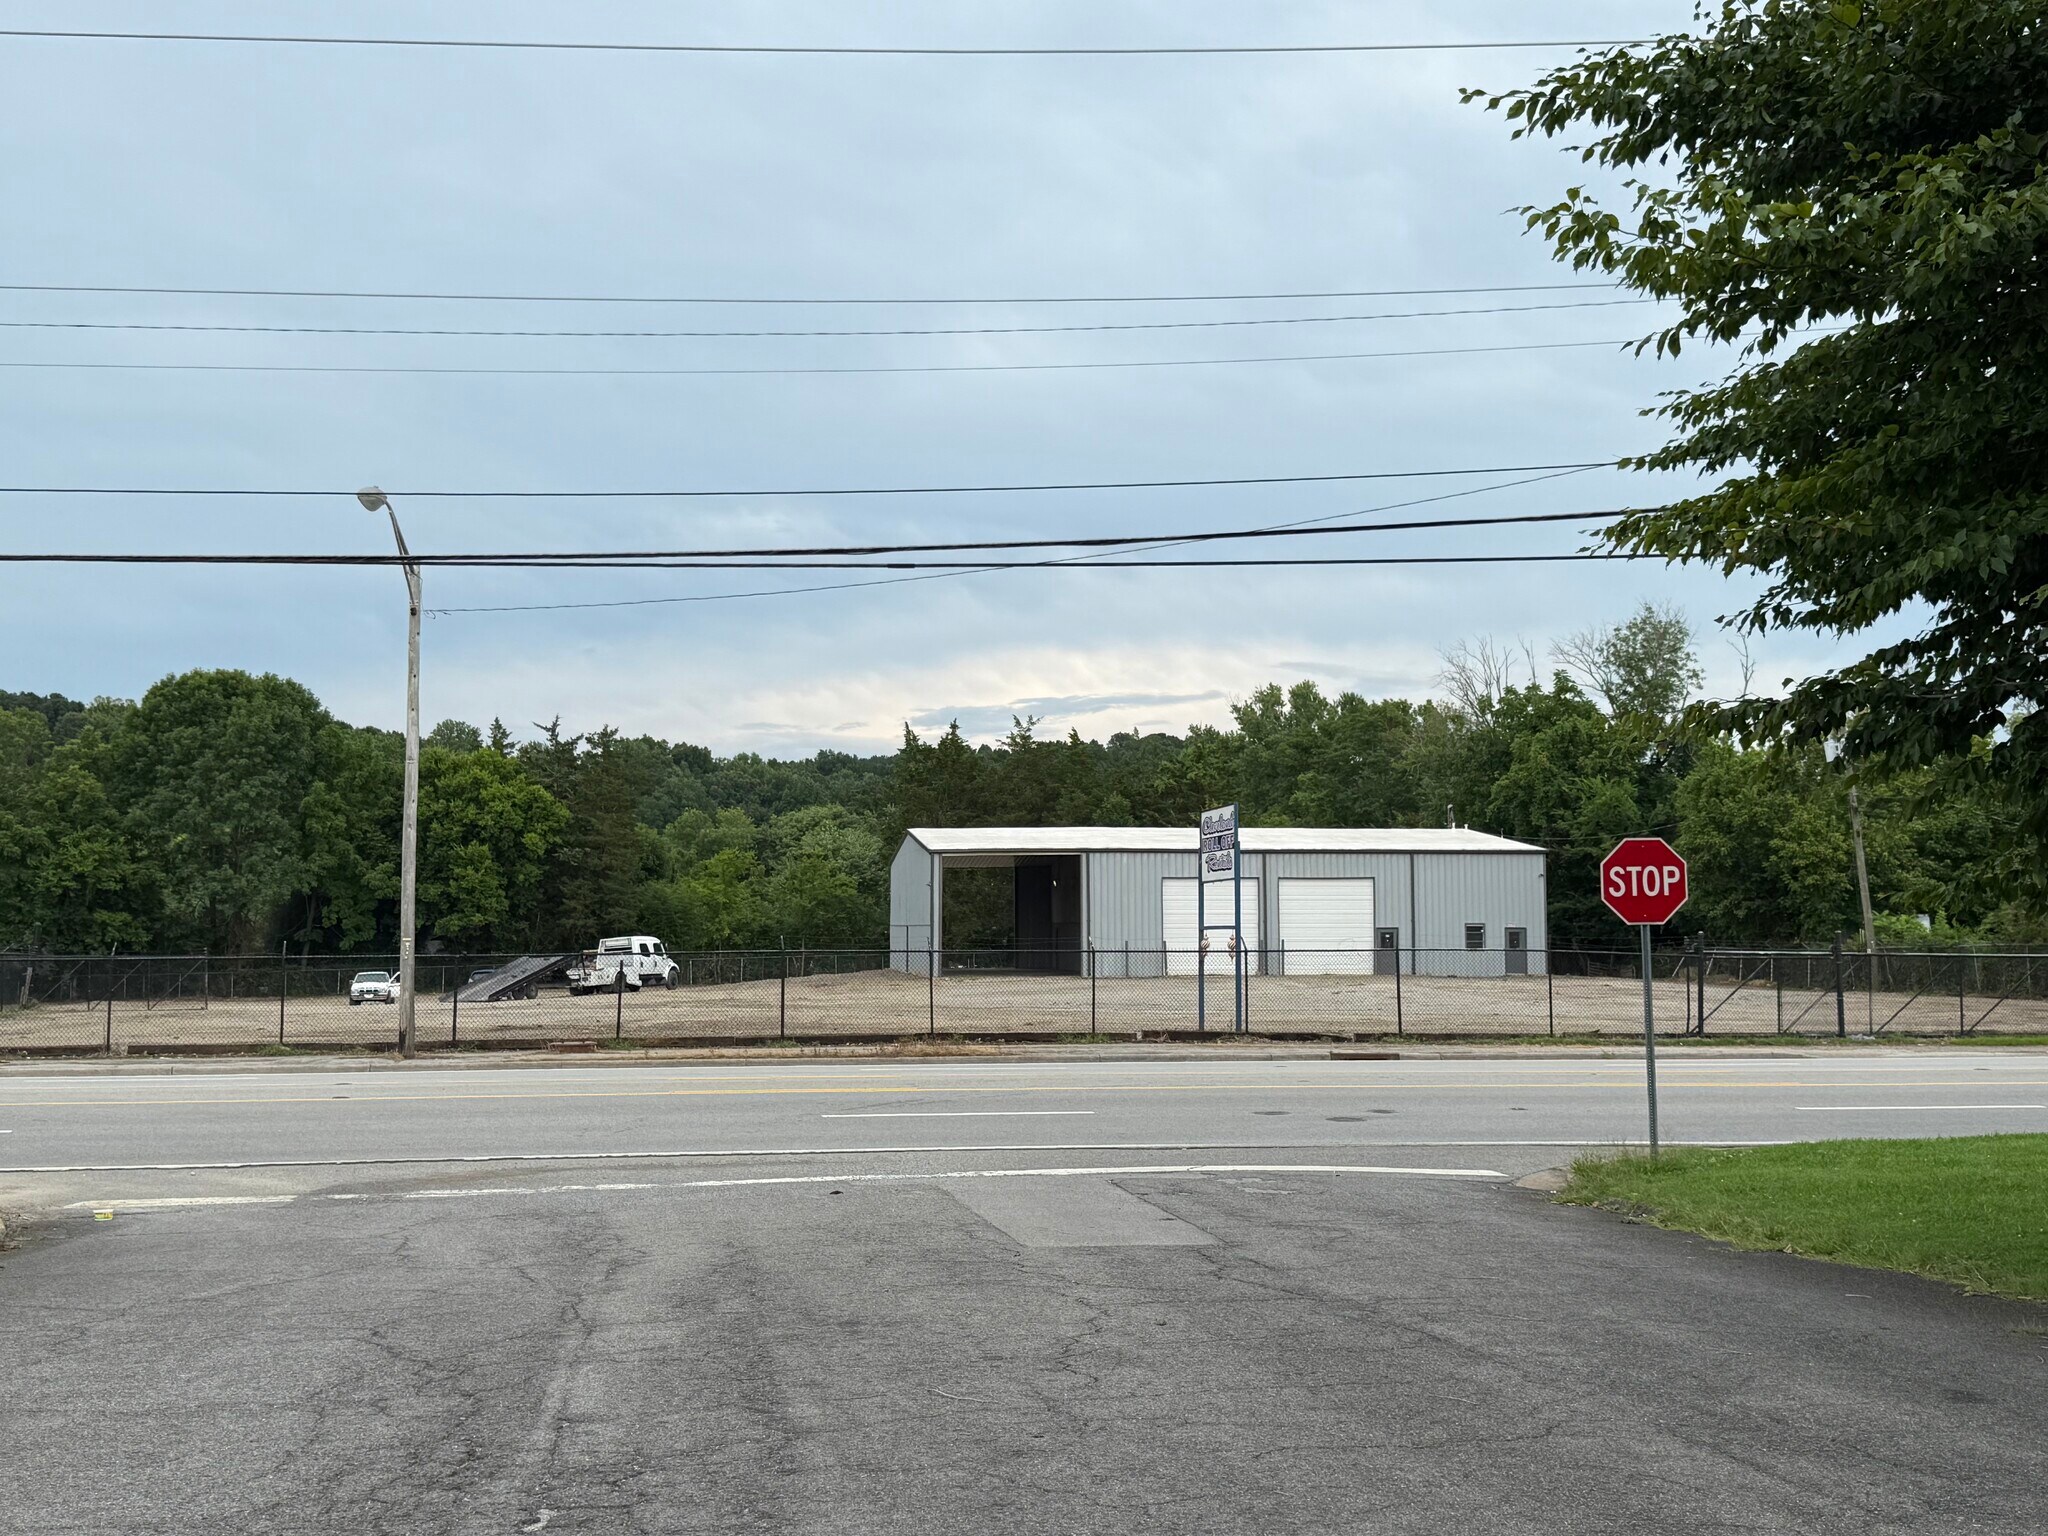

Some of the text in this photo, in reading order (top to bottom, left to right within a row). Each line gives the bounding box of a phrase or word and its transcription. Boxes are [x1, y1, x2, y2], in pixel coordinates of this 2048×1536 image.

[1203, 835, 1234, 852] ROLL OFF
[1608, 865, 1681, 897] STOP
